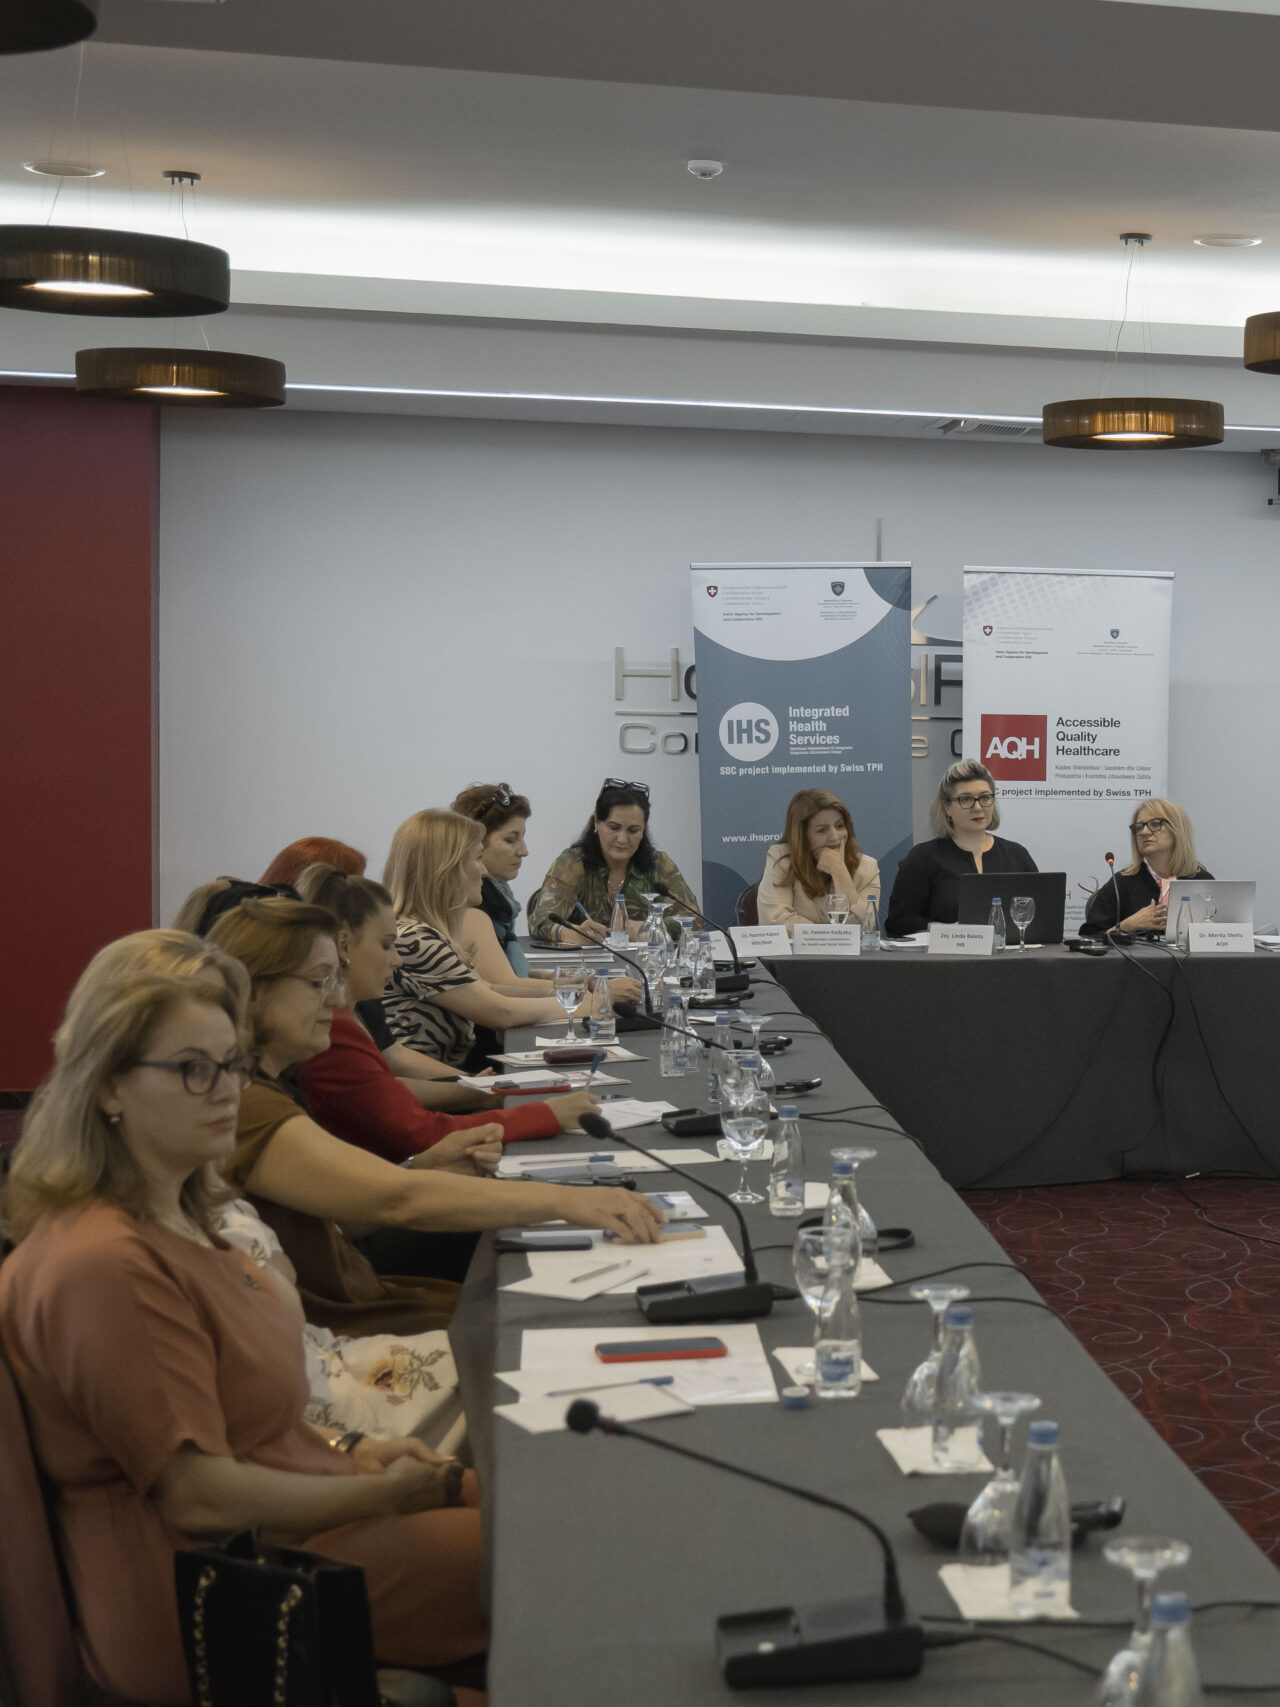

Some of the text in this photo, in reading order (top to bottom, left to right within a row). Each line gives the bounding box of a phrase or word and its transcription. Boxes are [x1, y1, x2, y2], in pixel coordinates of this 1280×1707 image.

[788, 705, 850, 719] Integrated
[788, 720, 827, 732] Health
[1055, 716, 1121, 728] Accessible
[727, 718, 772, 745] IHS
[1055, 730, 1098, 744] Quality
[788, 733, 840, 745] Services
[985, 736, 1040, 760] AQH
[1055, 745, 1121, 757] Healthcare
[719, 762, 883, 776] SDC project implemented by Swiss TPH
[1002, 787, 1032, 797] project
[1034, 787, 1090, 797] implemented
[1092, 788, 1103, 797] by
[1105, 788, 1131, 797] Swiss
[1134, 789, 1152, 797] TPH
